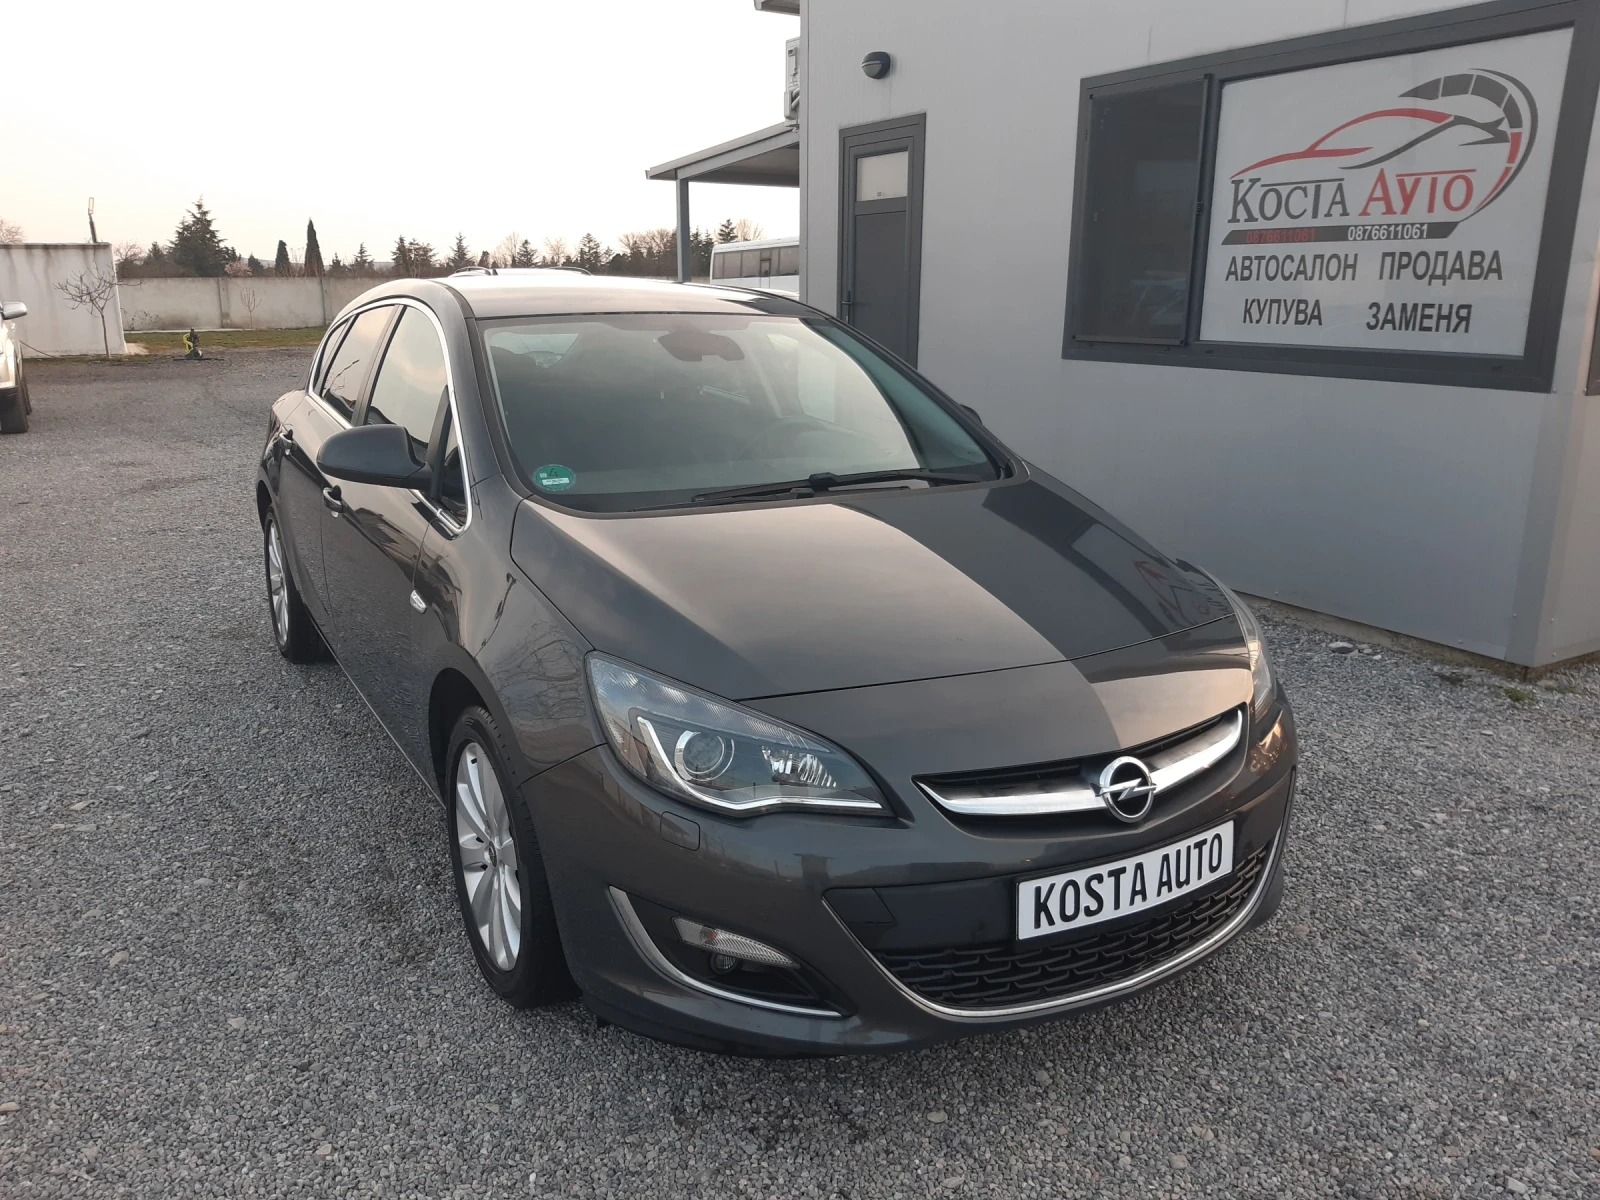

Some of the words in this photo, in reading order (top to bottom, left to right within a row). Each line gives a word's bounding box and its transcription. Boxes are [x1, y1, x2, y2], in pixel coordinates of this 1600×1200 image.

[1246, 227, 1315, 244] 0876611061
[1347, 224, 1428, 241] 0876611061
[1225, 253, 1358, 282] АВТОСАЛОН
[1379, 250, 1503, 286] ПРОДАВА
[1242, 298, 1323, 326] КУПУВА
[1366, 302, 1473, 333] ЗАМЕНЯ
[1033, 861, 1148, 930] KOSTA
[1156, 832, 1223, 898] AUTO
